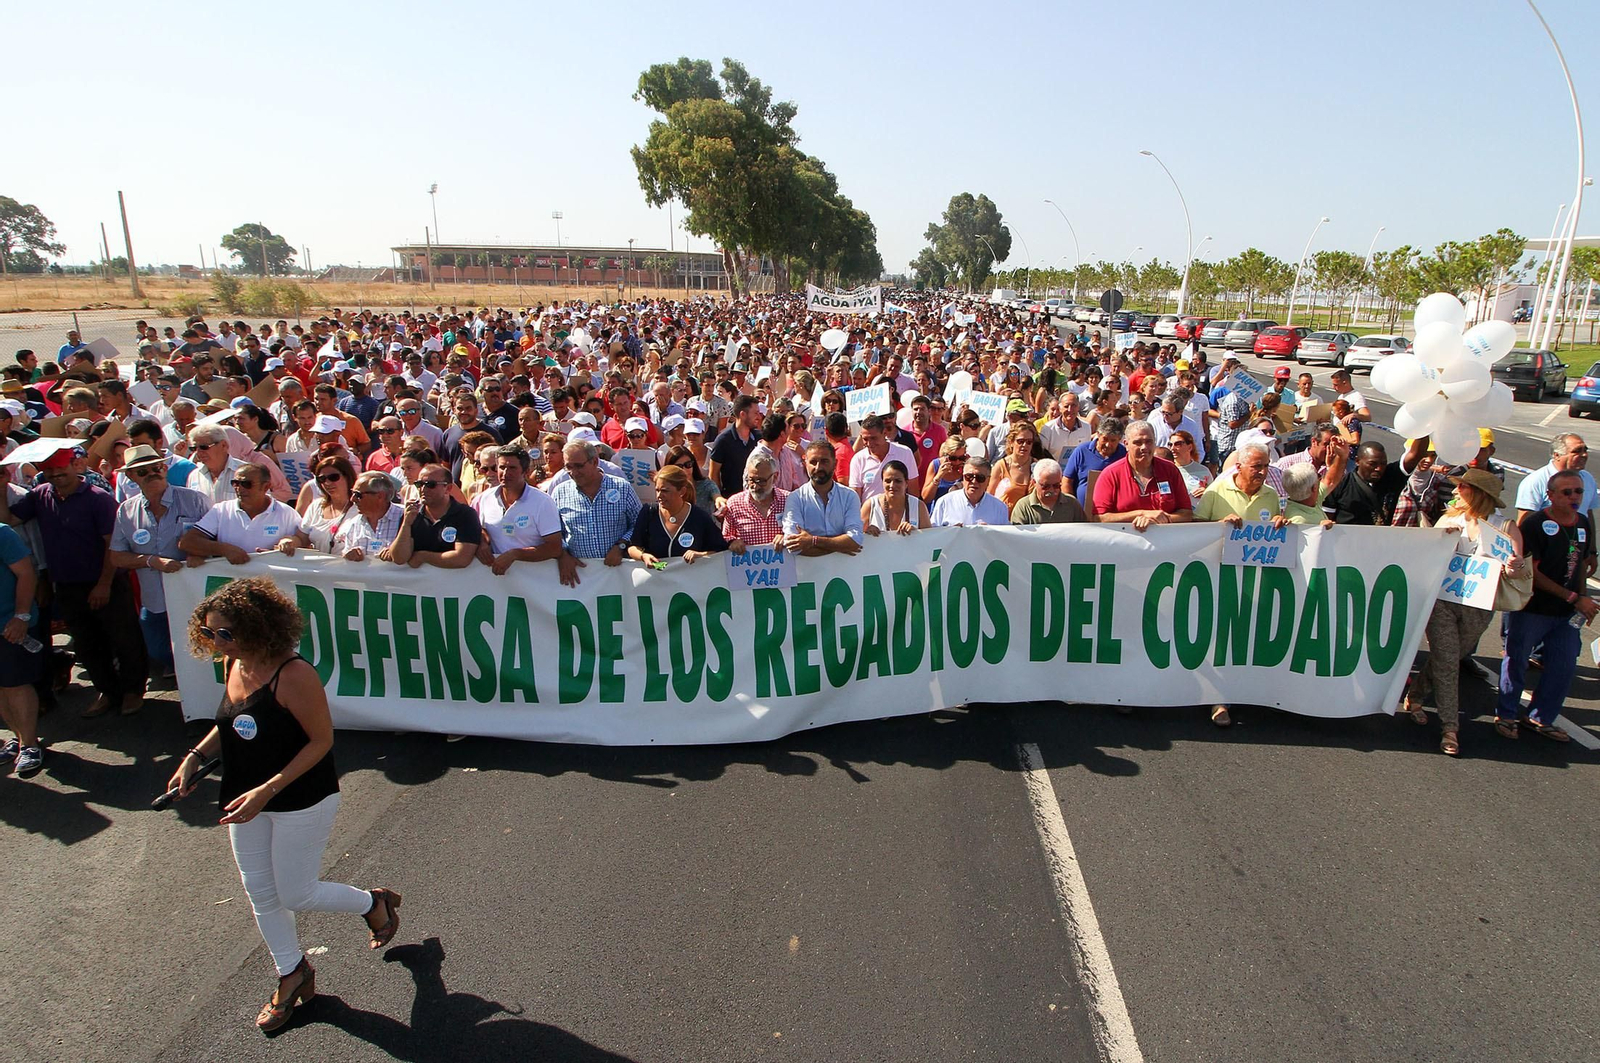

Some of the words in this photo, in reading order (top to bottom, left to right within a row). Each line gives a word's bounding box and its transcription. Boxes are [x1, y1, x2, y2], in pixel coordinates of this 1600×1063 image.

[811, 294, 850, 308] AGUA
[1242, 544, 1279, 565] YA!!
[744, 567, 780, 587] YA!!
[295, 584, 540, 704] DEFENSA
[556, 594, 626, 705] DE
[637, 586, 735, 703] LOS
[753, 548, 1011, 698] REGADÍOS
[1029, 561, 1122, 665] DEL
[1141, 561, 1409, 678] CONDADO
